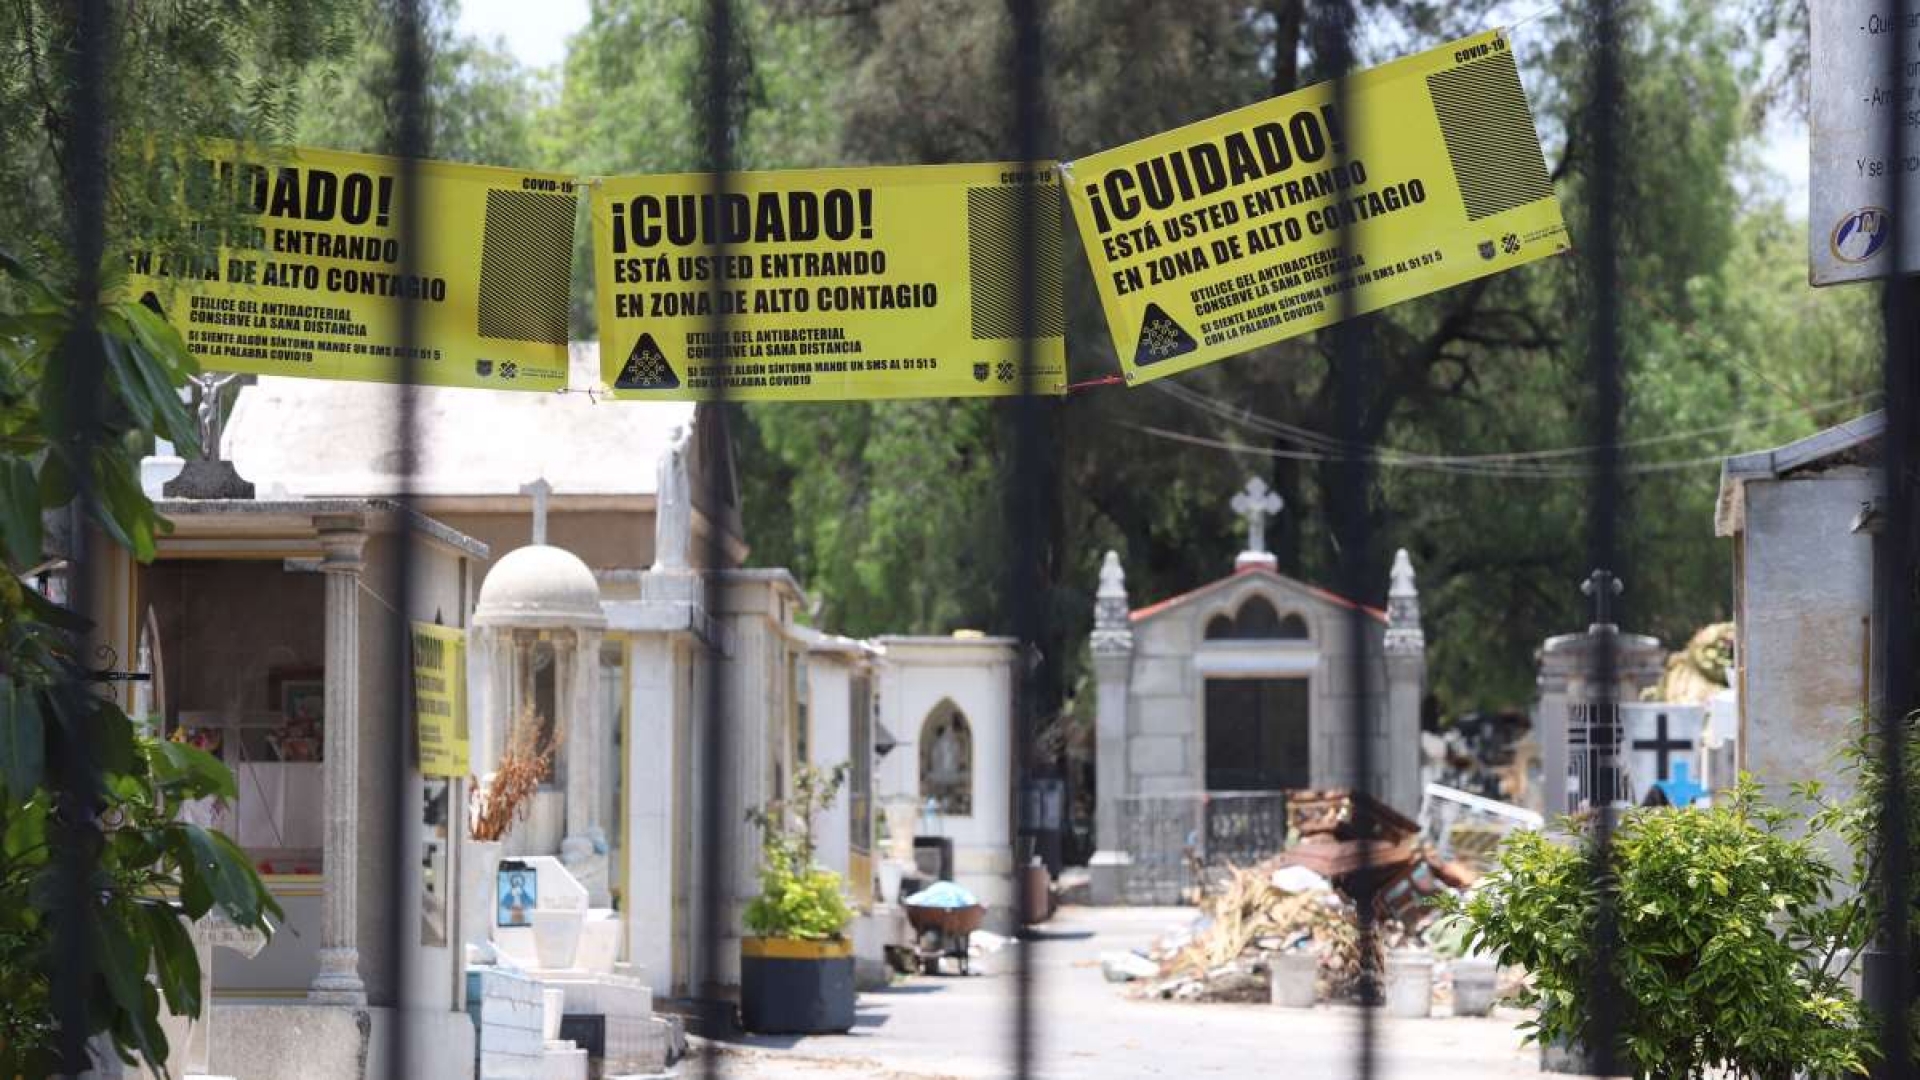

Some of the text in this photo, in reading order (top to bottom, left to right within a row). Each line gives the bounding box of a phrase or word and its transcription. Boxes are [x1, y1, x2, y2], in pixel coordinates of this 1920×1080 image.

[1455, 38, 1504, 62] COVID-19
[1086, 104, 1345, 234] ¡CUIDADO!
[522, 178, 573, 193] COVID-19
[612, 188, 873, 253] ¡CUIDADO!
[1102, 160, 1367, 262] ESTÁ USTED ENTRANDO
[274, 228, 399, 263] ENTRANDO
[1113, 266, 1144, 296] EN
[1146, 246, 1210, 285] ZONA
[1211, 235, 1243, 264] DE
[1246, 217, 1302, 254] ALTO
[227, 258, 257, 284] DE
[263, 262, 320, 290] ALTO
[614, 250, 886, 283] ESTÁ USTED ENTRANDO
[1190, 245, 1344, 303] UTILICE GEL ANTIBACTERIA
[616, 283, 937, 317] EN ZONA DE ALTO CONTAGIO
[1195, 288, 1254, 316] CONSERVE
[1255, 284, 1271, 298] LA
[1270, 274, 1301, 293] SANA
[1200, 323, 1211, 334] SI
[1213, 312, 1245, 330] SIENTE
[1278, 289, 1323, 309] SÍNTOMA
[1357, 272, 1371, 285] UN
[1372, 265, 1395, 280] SMS
[1396, 261, 1408, 273] AL
[1408, 256, 1421, 269] 51
[1421, 252, 1434, 265] 51
[1435, 249, 1443, 261] 5
[189, 310, 368, 336] CONSERVE LA SANA DISTANCIA
[191, 295, 351, 322] UTILICE GEL ANTIBACTERIAL
[1204, 300, 1325, 346] CON LA PALABRA COVID19
[188, 330, 199, 342] SI
[201, 332, 235, 344] SIENTE
[270, 335, 315, 350] SÍNTOMA
[318, 340, 351, 353] MANDE
[733, 330, 753, 343] GEL
[756, 327, 845, 343] ANTIBACTERIAL
[750, 343, 763, 356] LA
[765, 342, 797, 356] SANA
[799, 340, 862, 355] DISTANCIA
[186, 343, 313, 363] CON LA PALABRA COVID19
[768, 362, 812, 374] SÍNTOMA
[815, 361, 848, 372] MANDE
[851, 360, 864, 371] UN
[866, 359, 888, 370] SMS
[889, 359, 901, 370] AL
[903, 359, 915, 369] 51
[916, 358, 928, 369] 51
[930, 357, 937, 368] 5
[769, 375, 811, 386] COVID19
